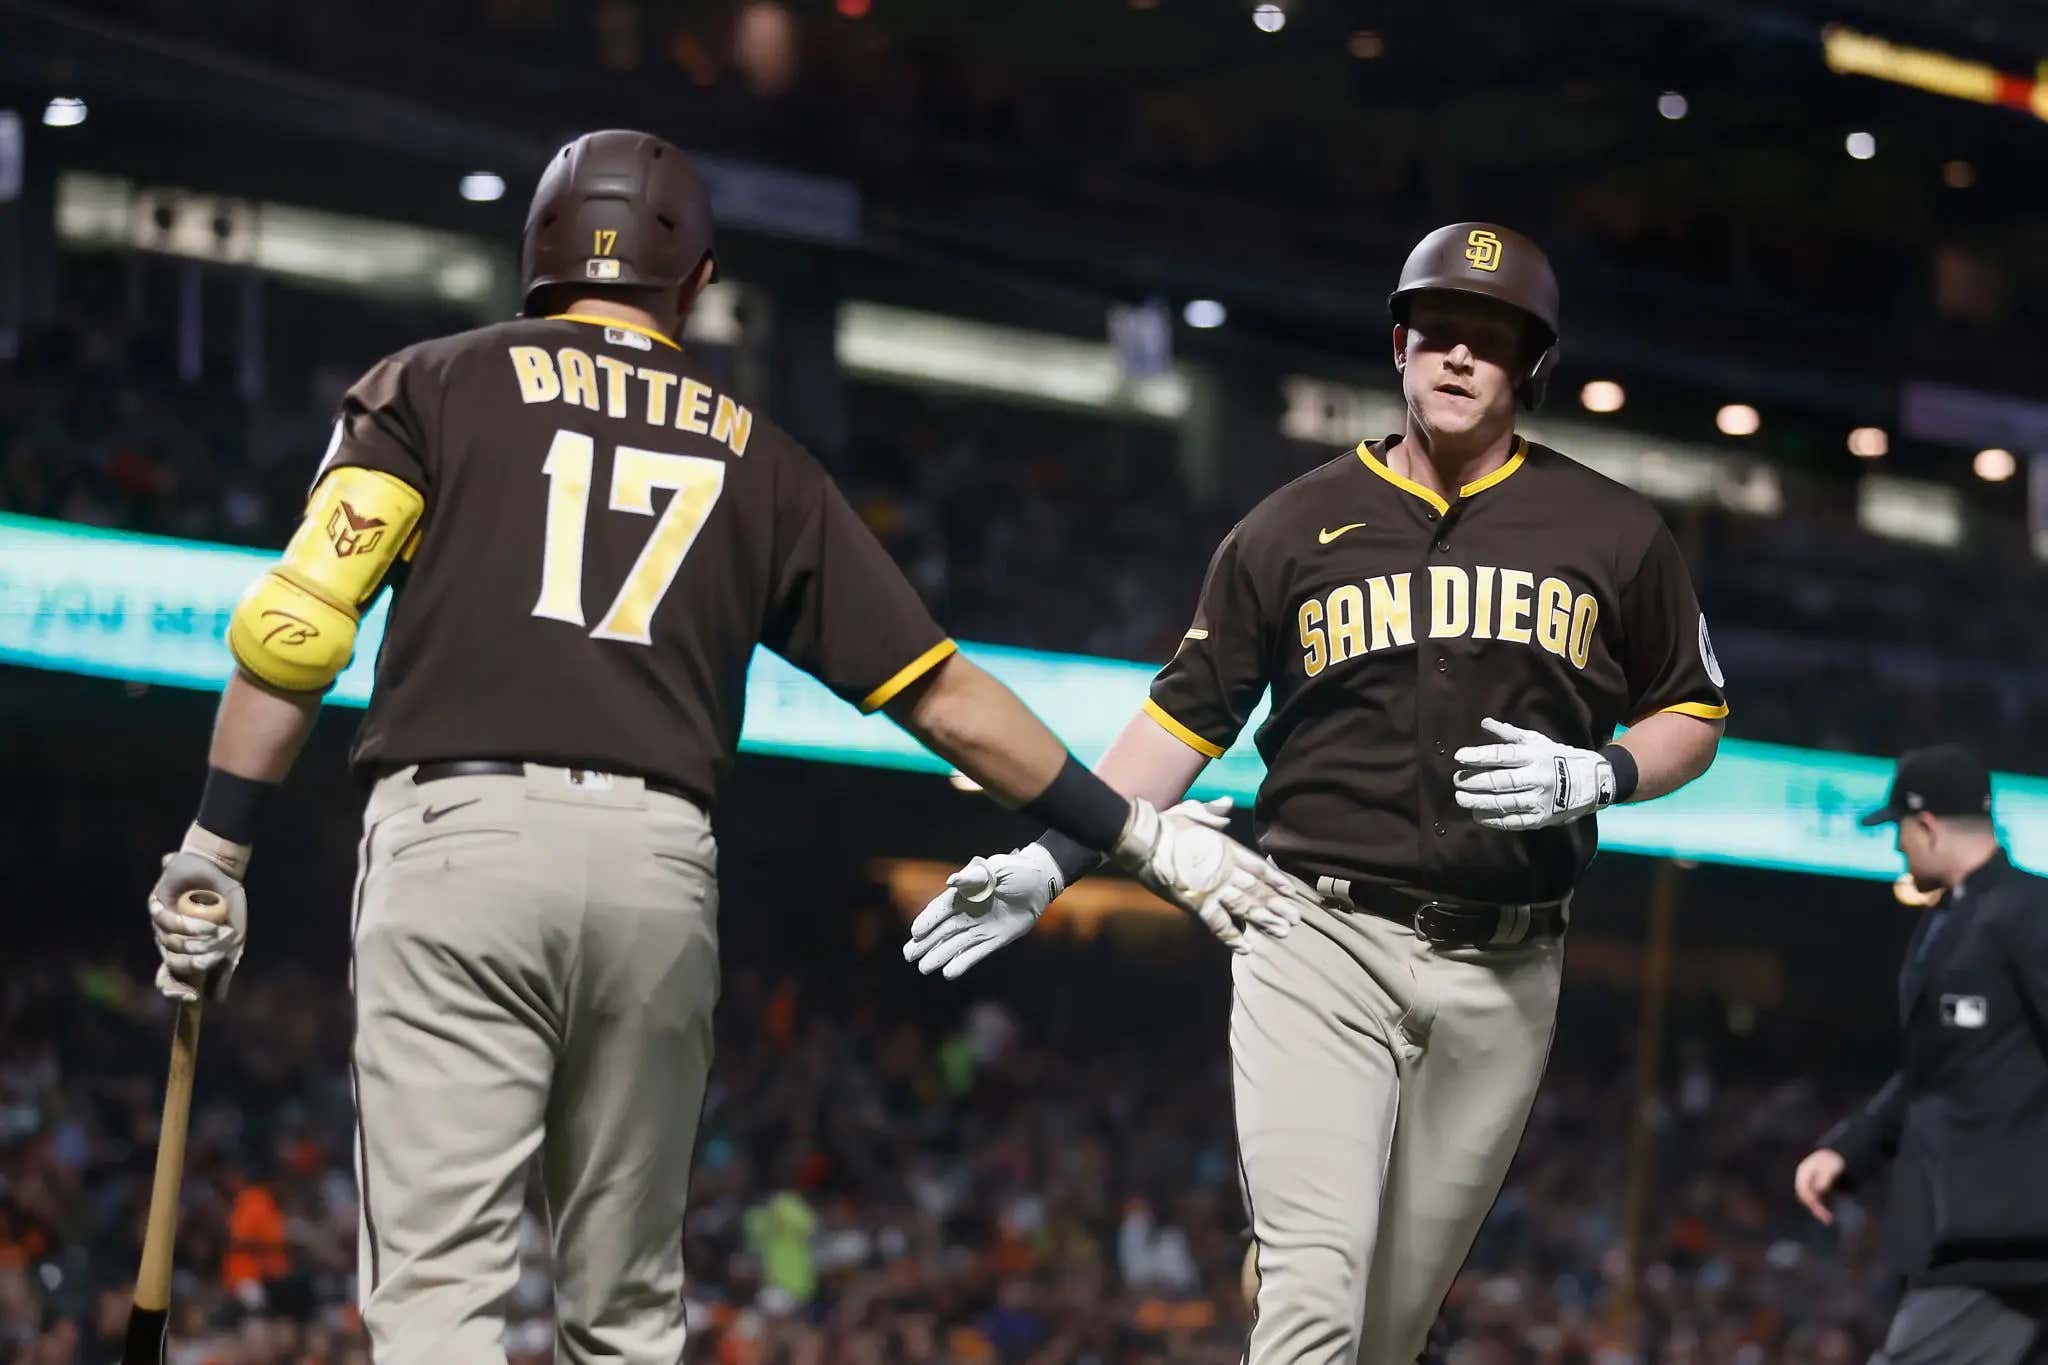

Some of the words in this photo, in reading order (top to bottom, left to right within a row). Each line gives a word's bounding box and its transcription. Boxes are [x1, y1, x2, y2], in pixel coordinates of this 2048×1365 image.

[593, 230, 617, 256] 17
[1465, 230, 1503, 272] SD
[509, 346, 752, 457] BATTEN
[531, 429, 725, 645] 17
[1298, 572, 1415, 678] SAN
[1427, 566, 1598, 670] DIEGO
